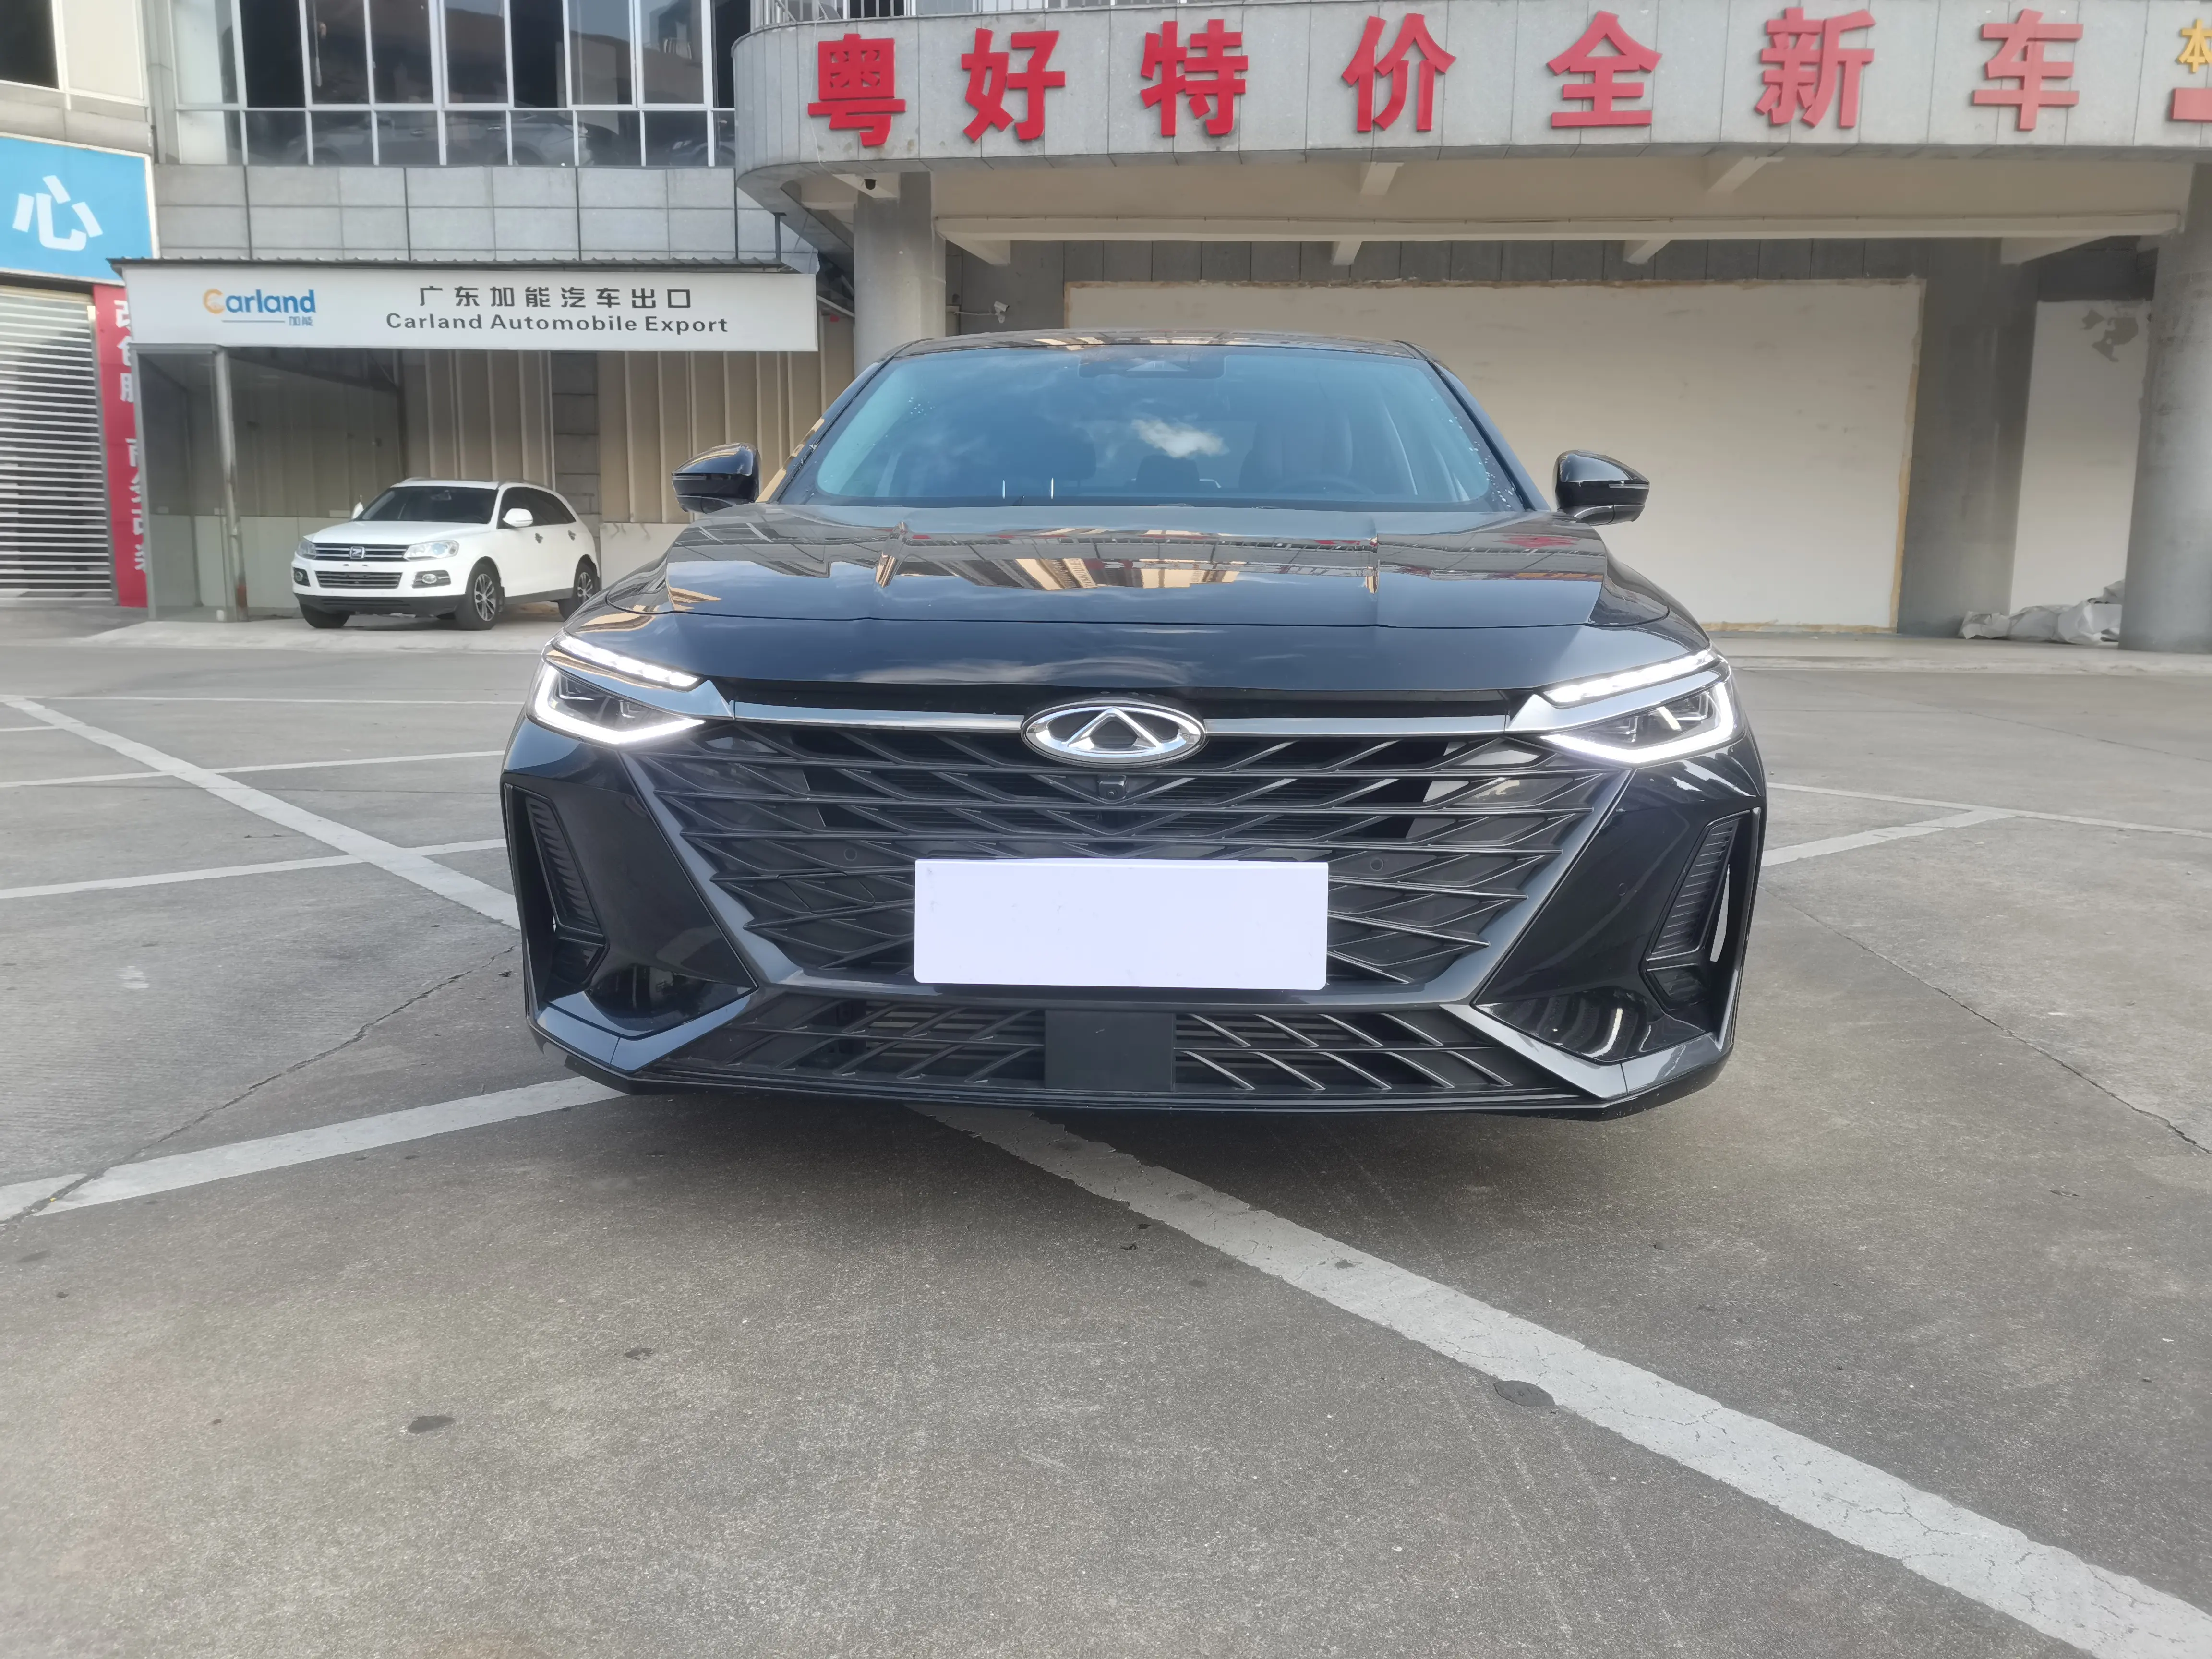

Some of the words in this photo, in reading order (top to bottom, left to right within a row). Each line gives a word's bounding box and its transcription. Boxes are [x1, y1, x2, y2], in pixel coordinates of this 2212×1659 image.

[808, 8, 2084, 147] 粤好特价全新车
[12, 175, 103, 251] 心
[203, 288, 316, 314] Carland
[419, 285, 692, 310] 广东加能汽车出口
[386, 313, 482, 329] Carland
[490, 314, 637, 331] Automobile
[645, 316, 728, 336] Export
